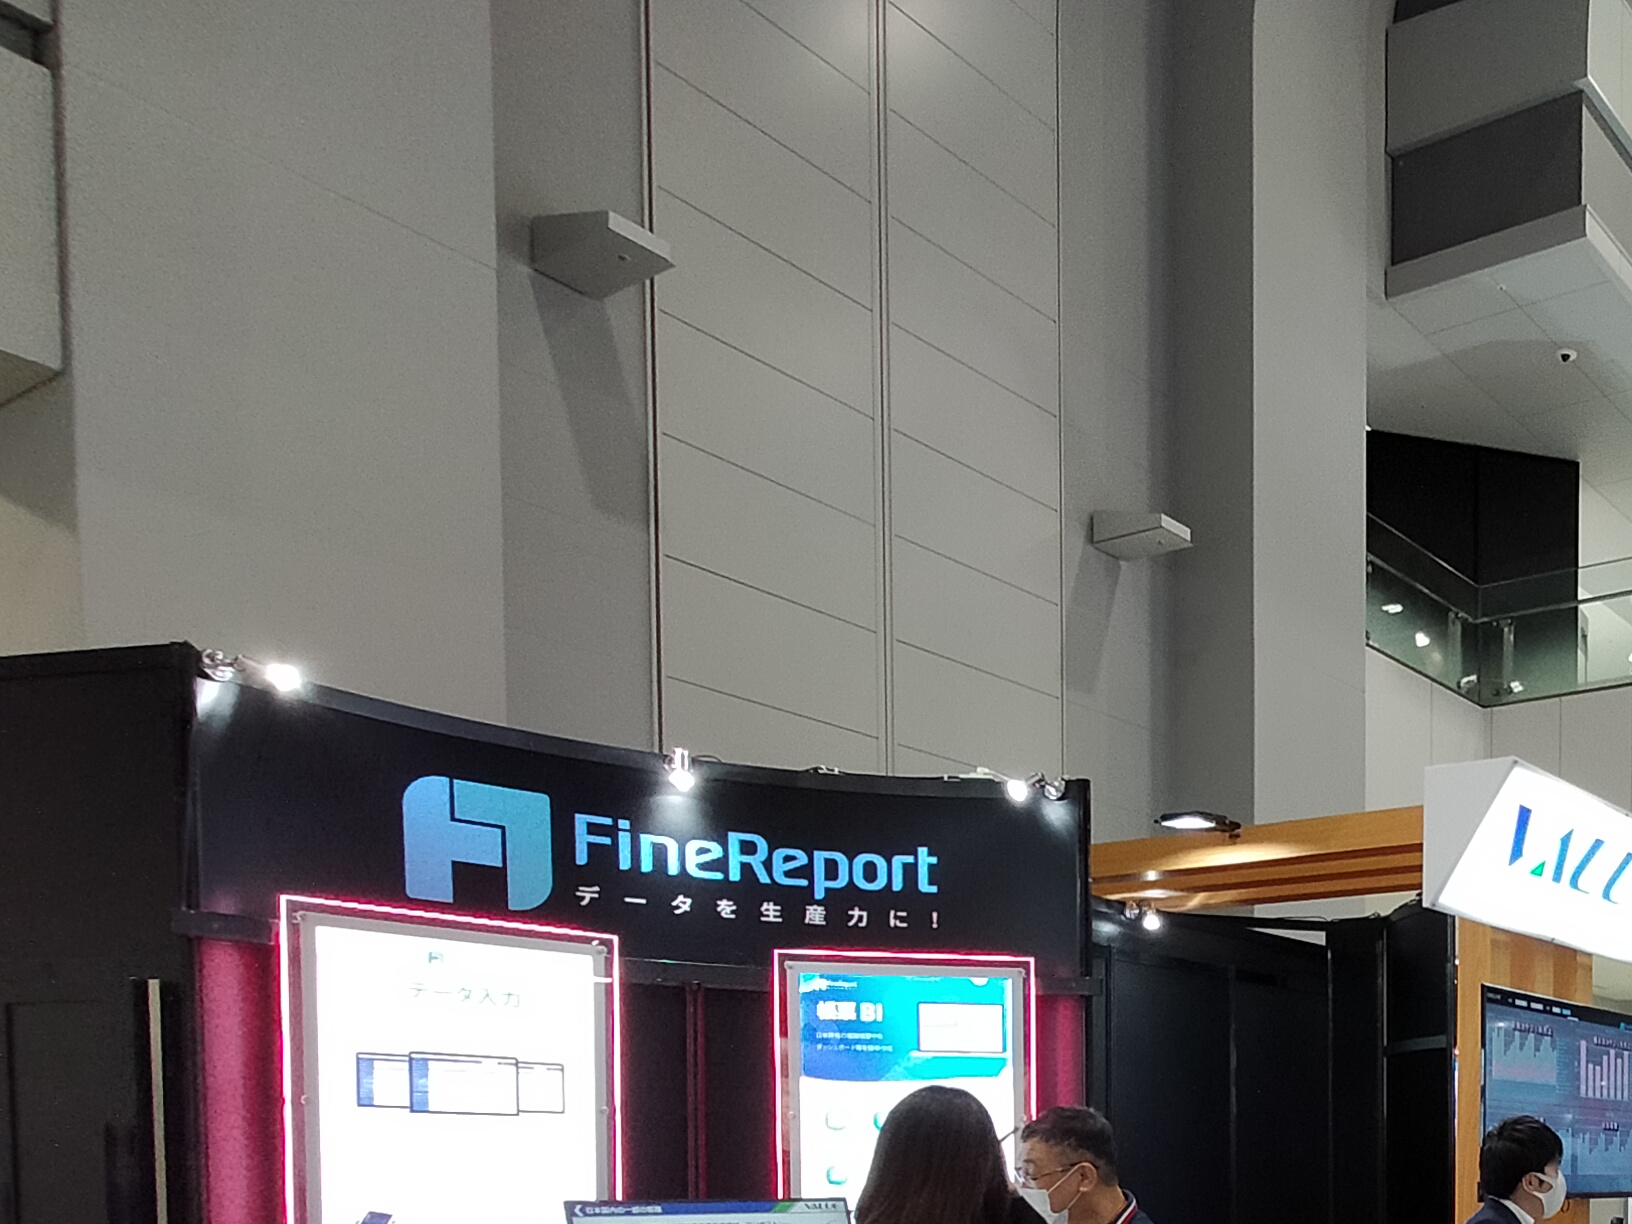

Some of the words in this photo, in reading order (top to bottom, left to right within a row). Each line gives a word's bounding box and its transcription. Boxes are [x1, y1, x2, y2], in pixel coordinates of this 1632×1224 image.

[574, 813, 939, 899] FineReport
[575, 884, 940, 929] データを生産力に！
[410, 982, 521, 1008] データ入力
[860, 1002, 883, 1022] BI
